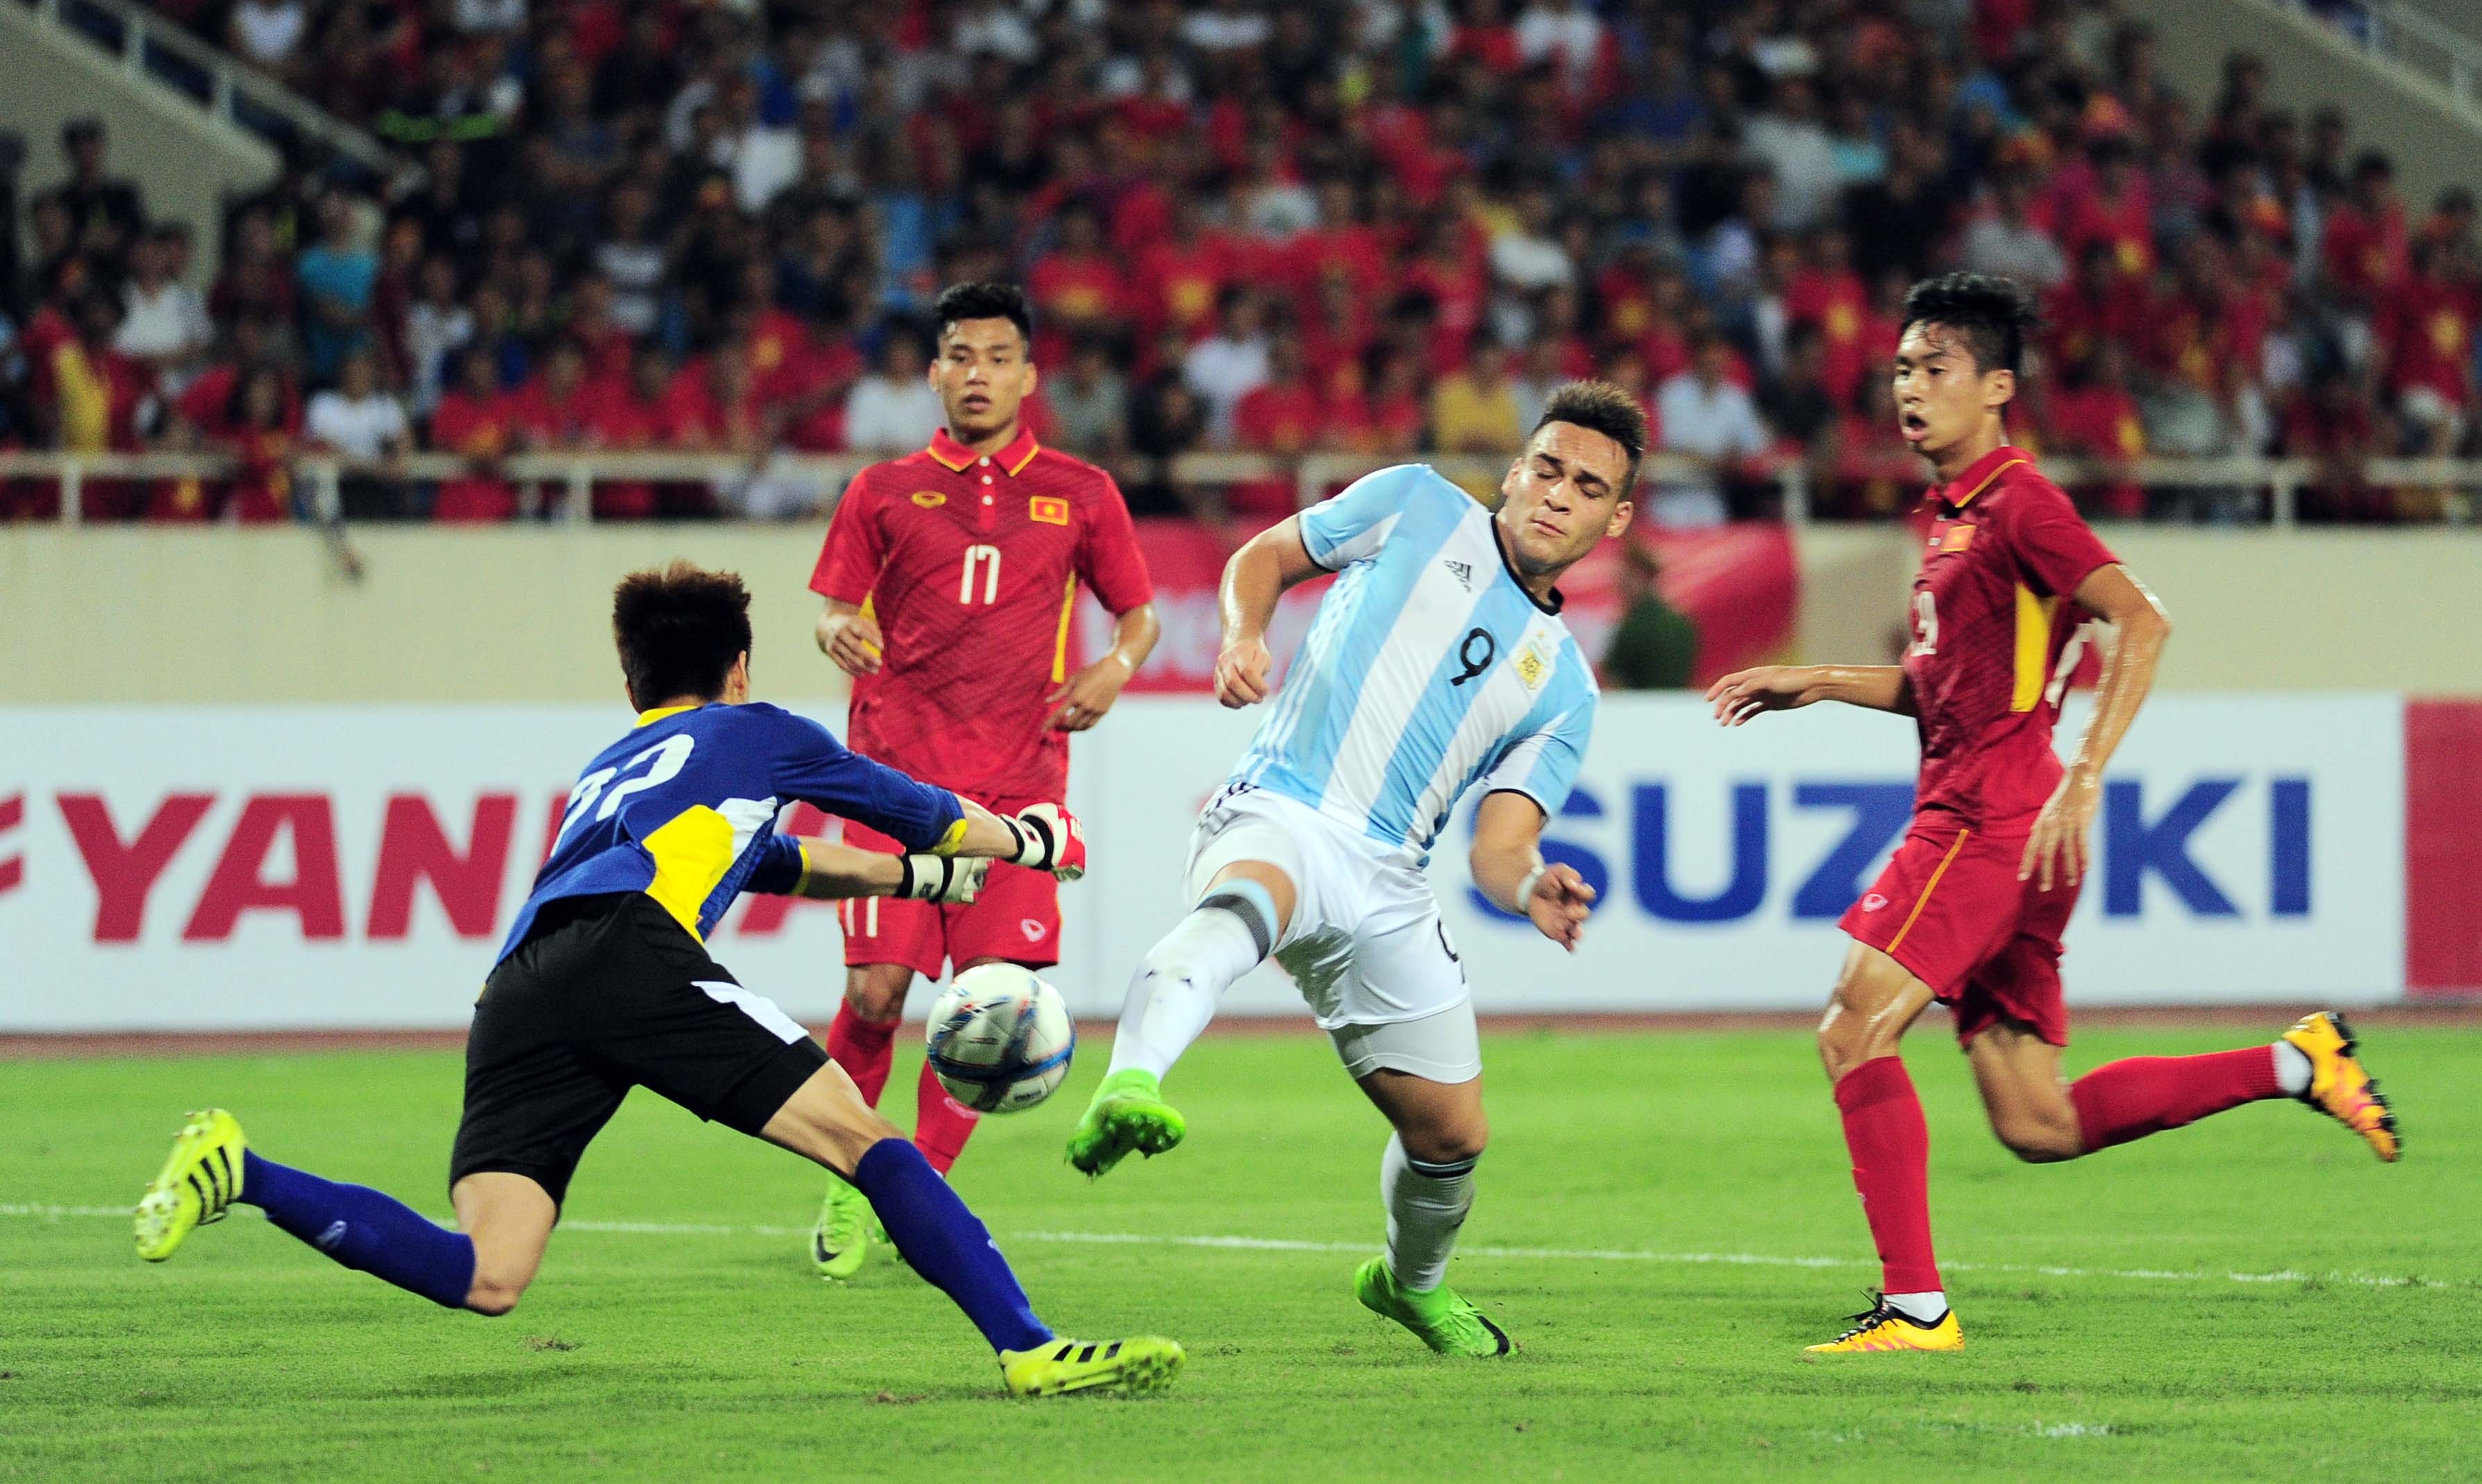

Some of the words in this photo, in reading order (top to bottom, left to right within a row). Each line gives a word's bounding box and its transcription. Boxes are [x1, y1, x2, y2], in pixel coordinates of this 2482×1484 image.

[959, 545, 1001, 605] 17
[1450, 627, 1495, 686] 9
[56, 793, 848, 941] YAN
[1467, 779, 2312, 922] SUZKI
